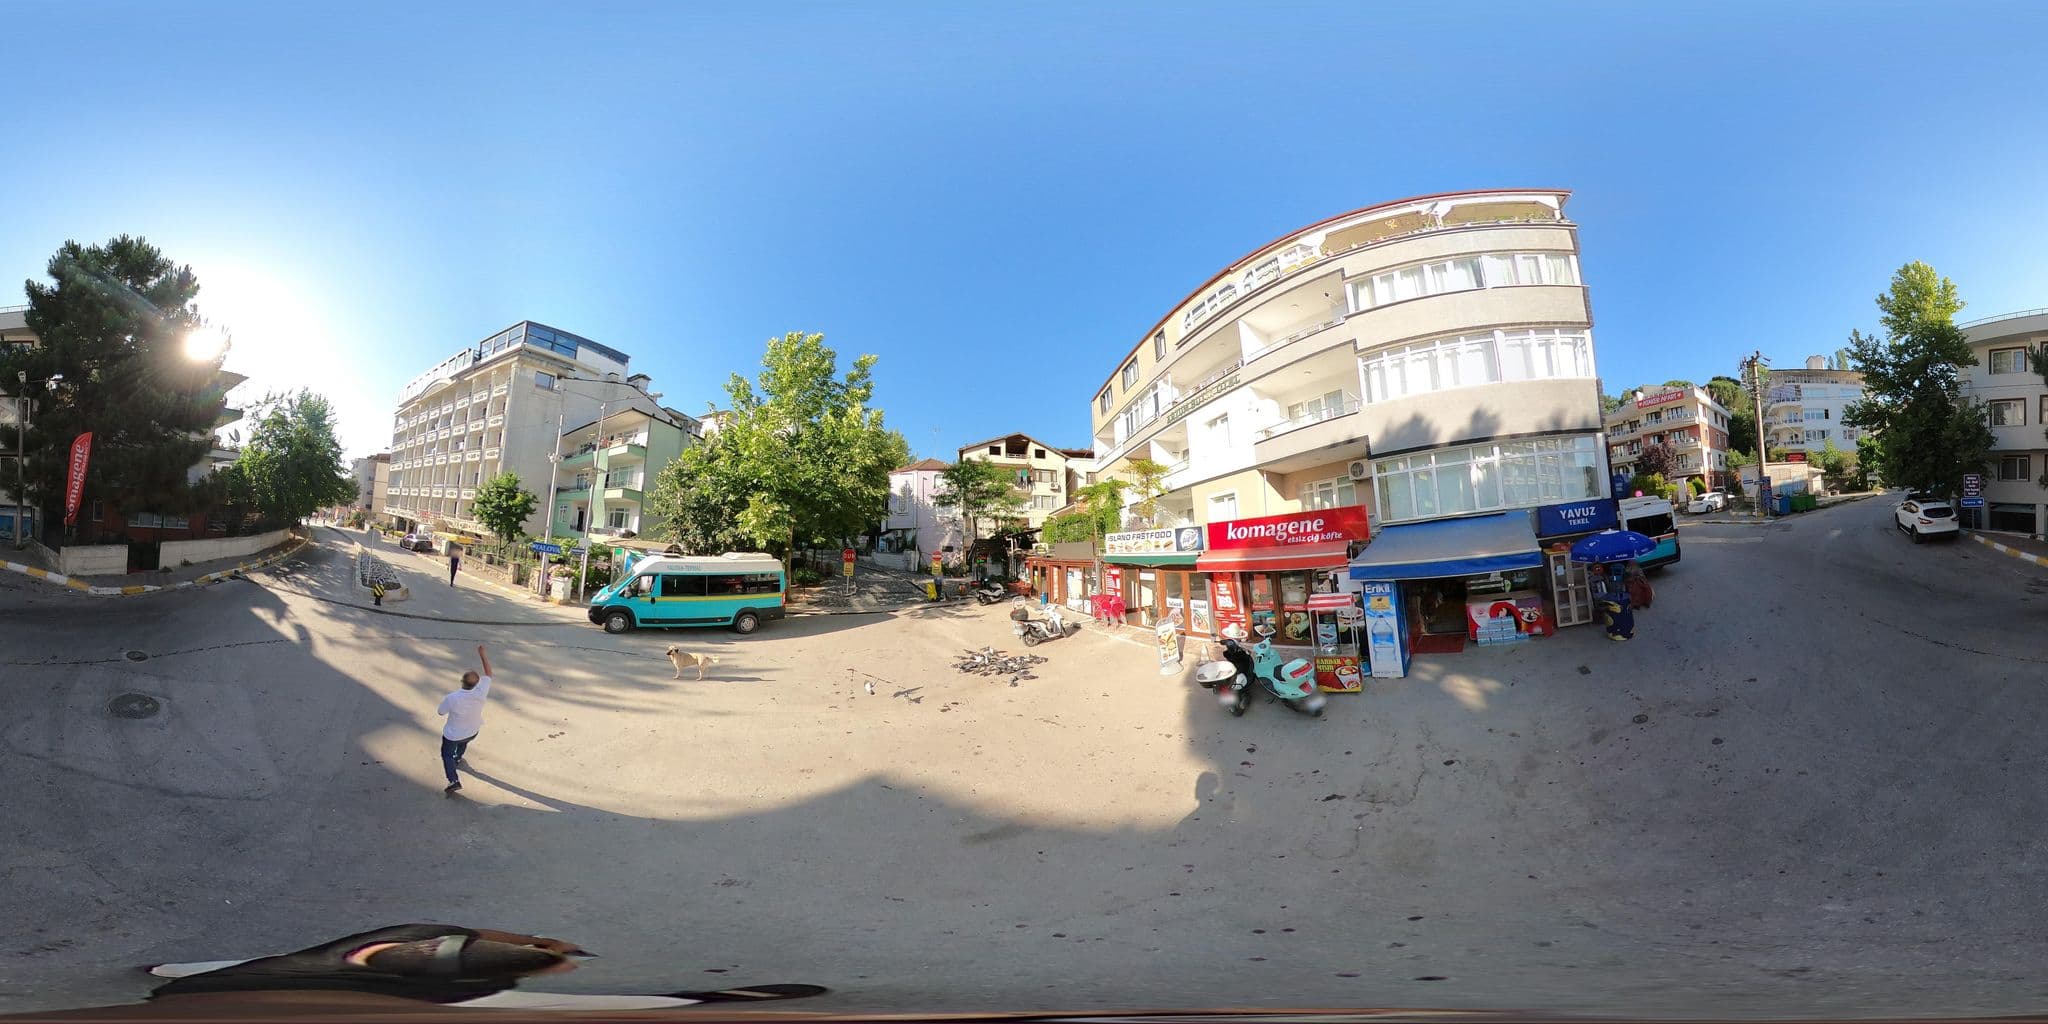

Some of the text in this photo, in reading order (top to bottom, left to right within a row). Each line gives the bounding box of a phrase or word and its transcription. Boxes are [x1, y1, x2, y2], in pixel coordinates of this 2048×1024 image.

[1560, 507, 1596, 519] YAVUZ
[1568, 518, 1590, 526] TEKEL
[1227, 518, 1325, 541] komagene
[1131, 530, 1172, 541] FASTFOOD
[1320, 532, 1342, 540] köfte
